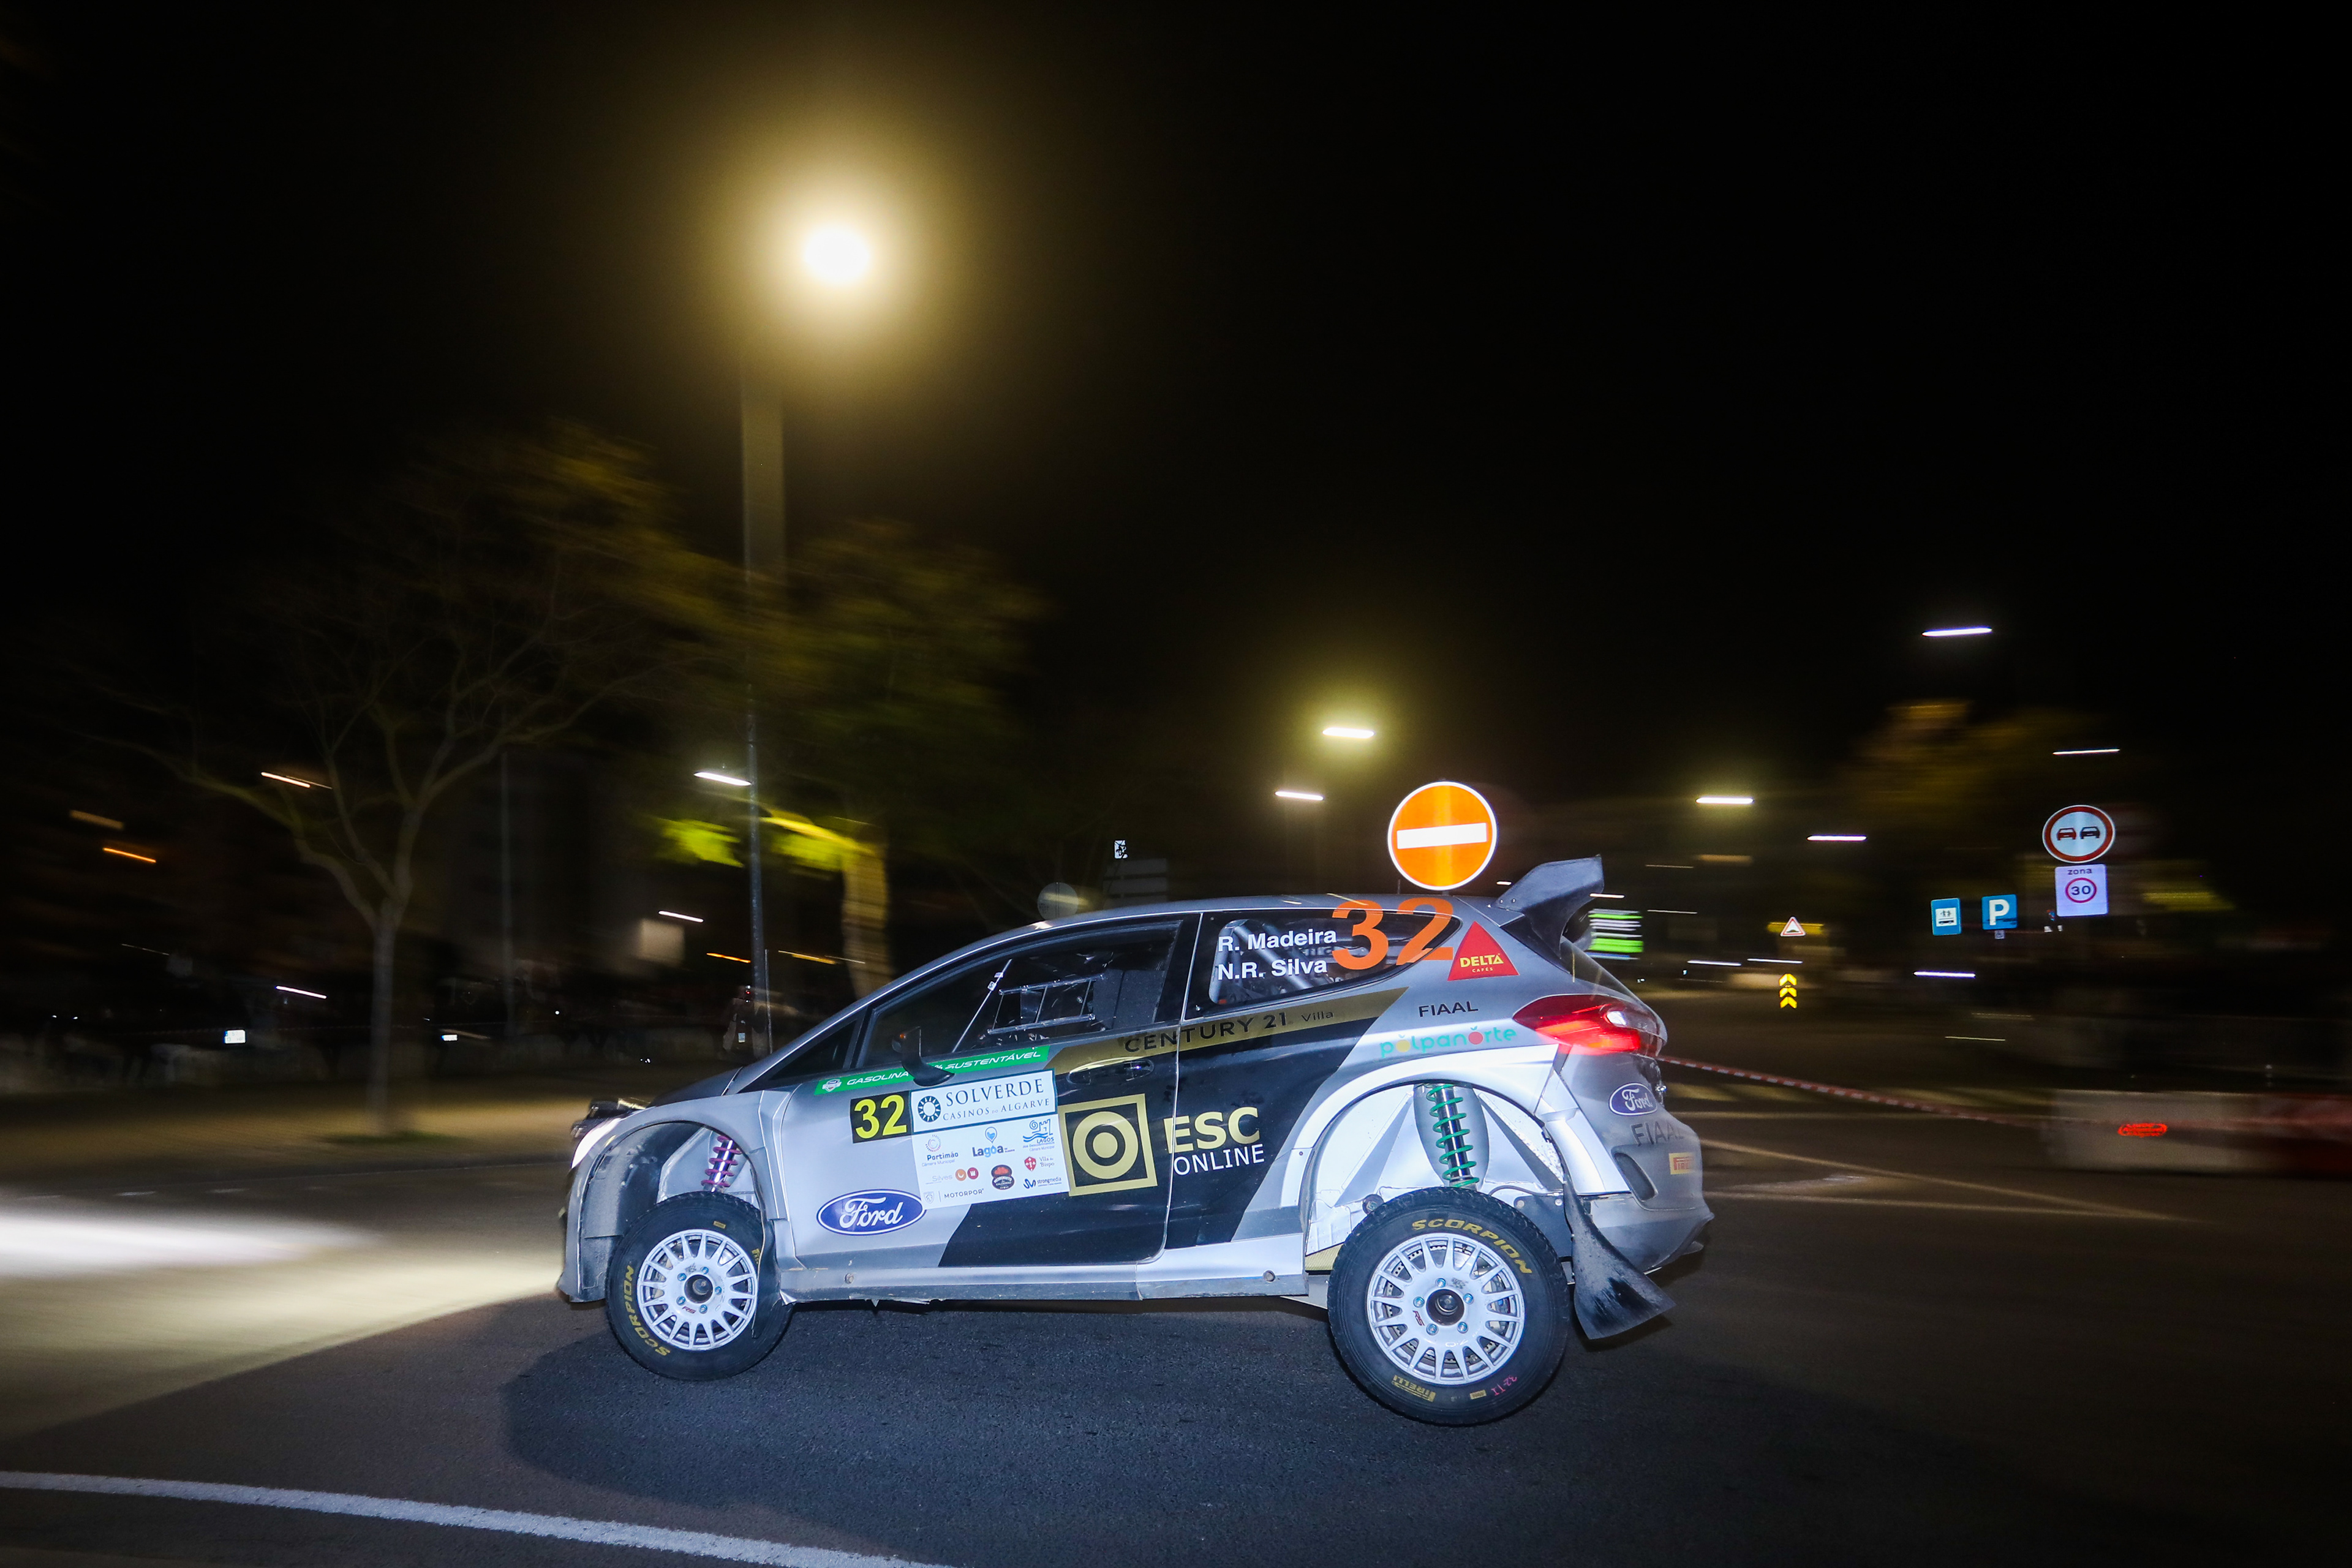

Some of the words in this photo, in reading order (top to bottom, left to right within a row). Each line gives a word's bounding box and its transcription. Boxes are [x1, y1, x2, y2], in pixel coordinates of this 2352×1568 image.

[2067, 866, 2092, 876] zona
[2070, 884, 2092, 895] 30
[1989, 899, 2010, 925] P
[1218, 934, 1240, 952] R.
[1248, 929, 1337, 950] Madeira
[1331, 897, 1453, 970] 32
[1218, 960, 1264, 981] N.R.
[1271, 958, 1327, 977] Silva
[1460, 954, 1504, 968] DELTA
[1419, 1001, 1479, 1017] FIAAL
[1125, 1017, 1255, 1053] CENTURY
[1263, 1012, 1287, 1030] 21
[1301, 1011, 1334, 1022] Villa
[1379, 1026, 1517, 1058] polpanorte
[846, 1071, 909, 1086] GASOLINA
[944, 1052, 1041, 1069] SUSTENTÁVEL
[946, 1078, 1044, 1107] SOLVERDE
[1621, 1088, 1653, 1111] Ford
[854, 1095, 907, 1139] 32
[943, 1107, 990, 1121] CASINOS
[1001, 1098, 1050, 1113] ALGARVE
[1163, 1106, 1260, 1154] ESC
[927, 1152, 959, 1161] Portimão
[972, 1145, 1005, 1158] Lagoa
[1174, 1144, 1265, 1175] ONLINE
[944, 1189, 982, 1199] MOTORPOR
[839, 1196, 904, 1229] Ford
[1412, 1218, 1532, 1274] SCORPION
[624, 1265, 671, 1356] SCORPION
[1412, 1310, 1425, 1327] RS
[1391, 1374, 1436, 1403] PIRELLI
